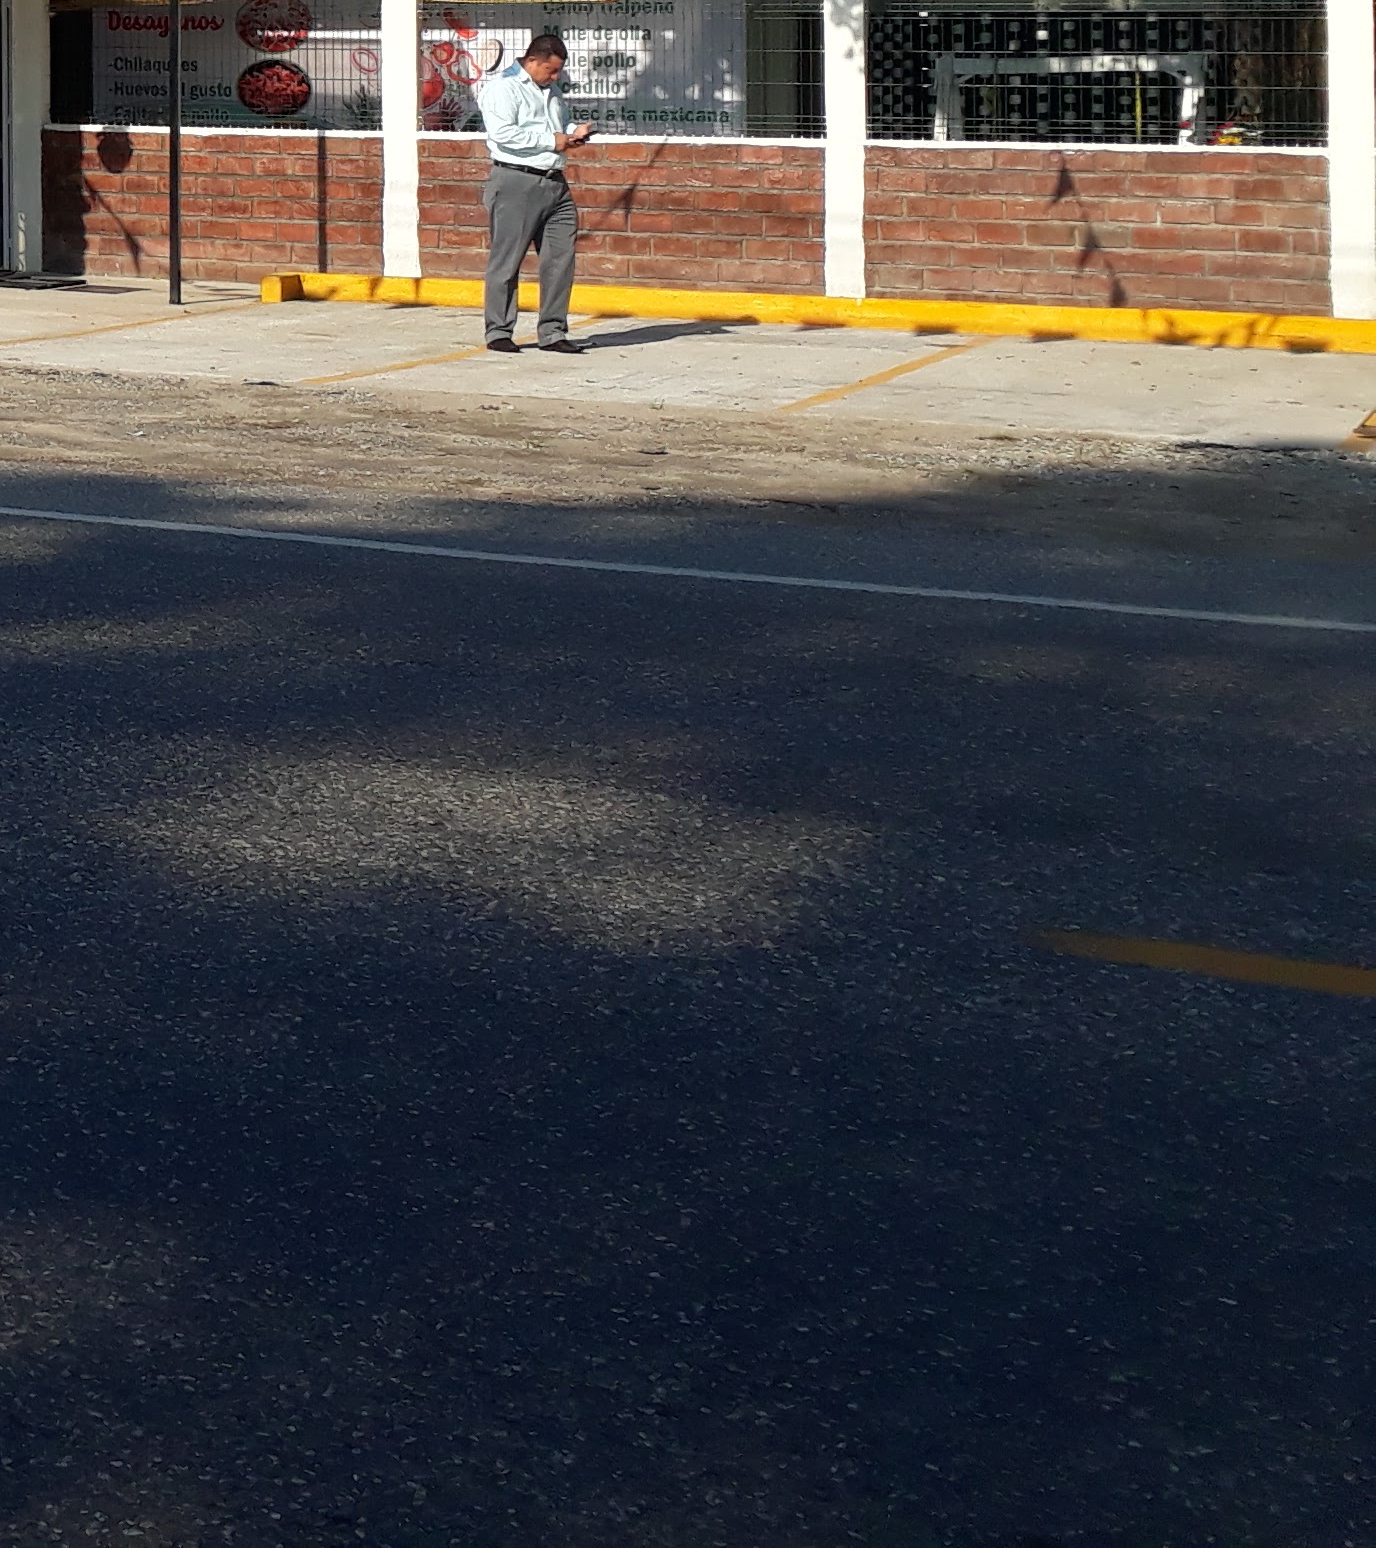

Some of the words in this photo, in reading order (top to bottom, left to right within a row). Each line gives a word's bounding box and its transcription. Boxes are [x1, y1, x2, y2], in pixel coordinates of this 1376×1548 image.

[108, 10, 224, 37] Desaynos
[593, 25, 614, 40] de
[109, 56, 198, 74] -Chilaques
[593, 52, 636, 70] pollo
[190, 81, 232, 100] gusto
[561, 78, 621, 95] cadillo
